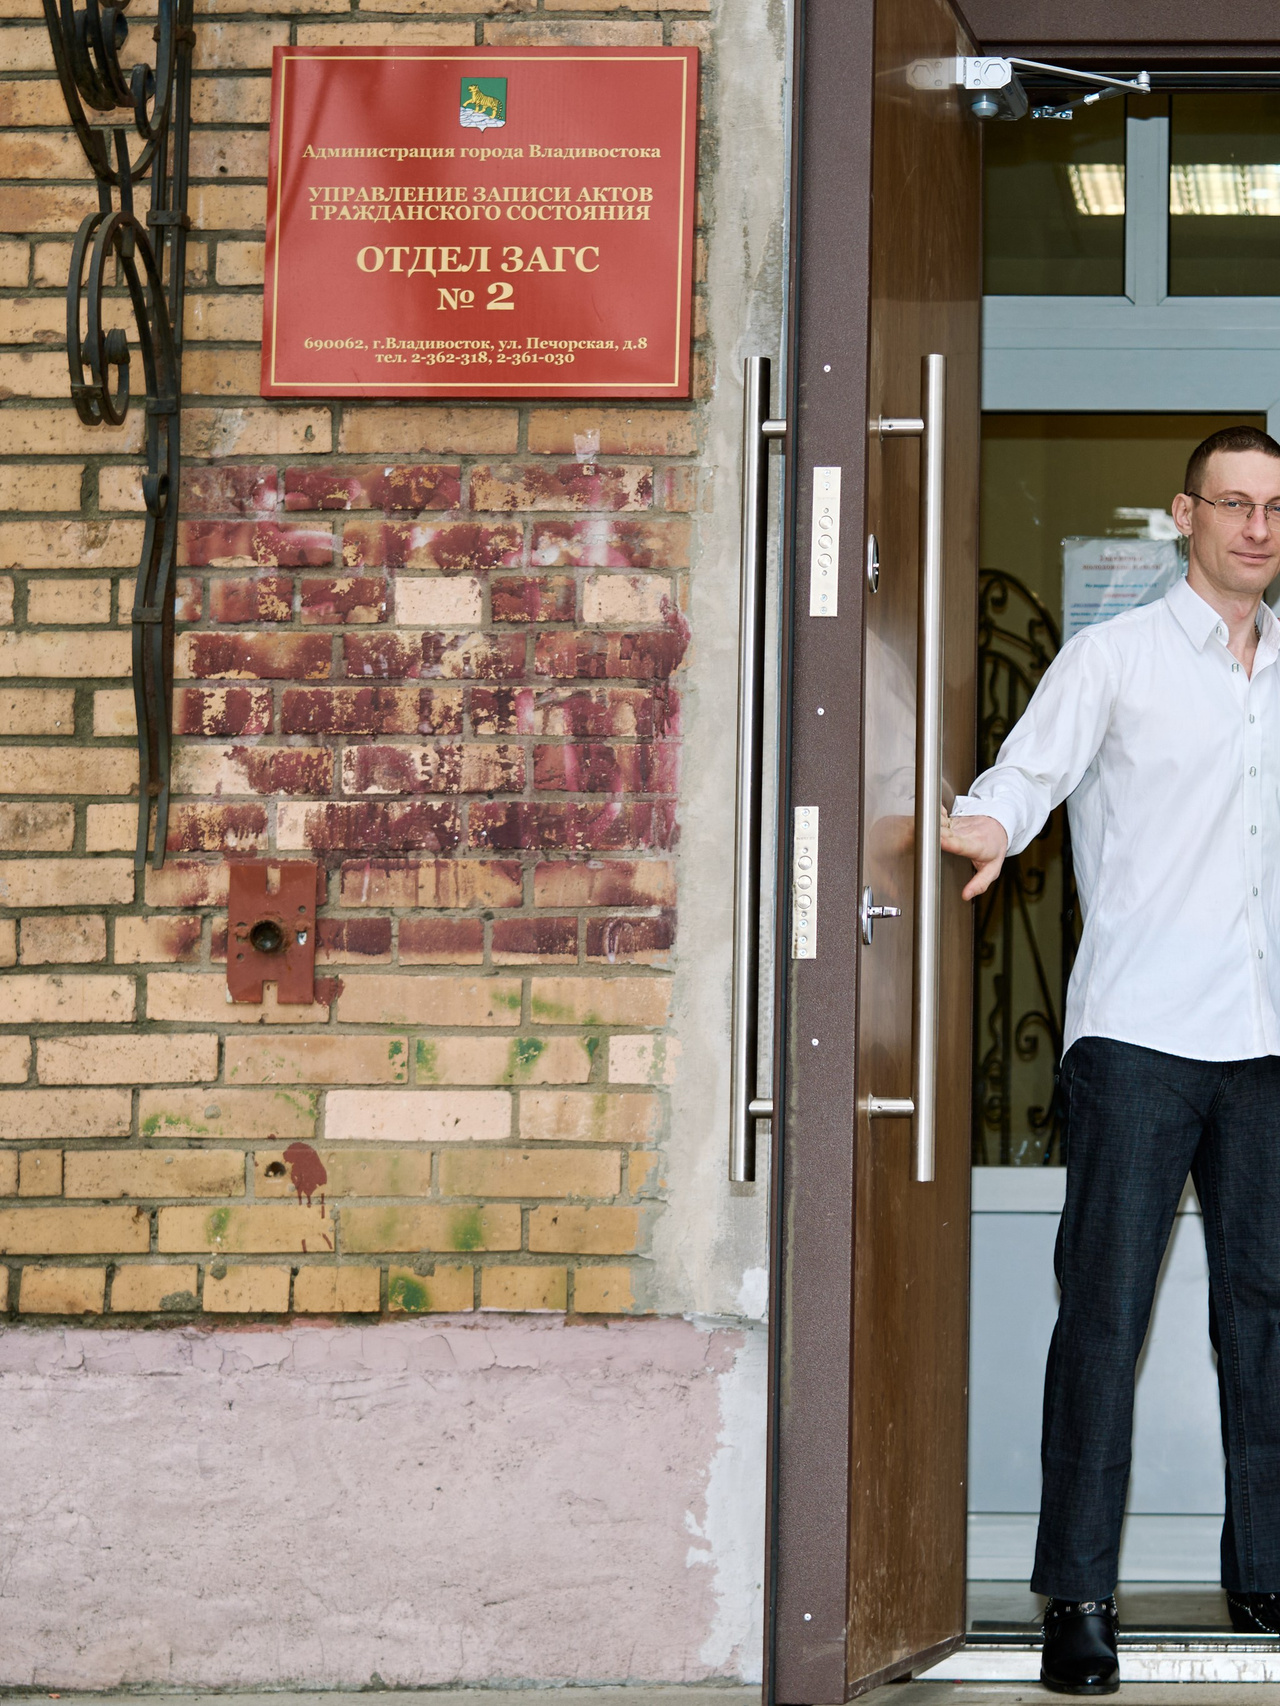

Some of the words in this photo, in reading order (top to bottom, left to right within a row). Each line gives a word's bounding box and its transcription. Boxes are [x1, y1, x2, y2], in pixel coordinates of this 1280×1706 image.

[303, 145, 455, 161] Администрация
[461, 148, 524, 161] города
[529, 145, 661, 159] Владивостока
[308, 187, 468, 202] УПРАВЛЕНИЕ
[473, 187, 571, 202] ЗАПИСИ
[576, 187, 653, 202] АКТОВ
[310, 205, 501, 223] ГРАЖДАНСКОГО
[507, 205, 650, 220] СОСТОЯНИЯ
[356, 246, 491, 277] ОТДЕЛ
[501, 246, 599, 272] ЗАГС
[437, 288, 474, 310] №
[487, 282, 514, 310] 2
[304, 338, 368, 351] 690062,
[498, 341, 522, 352] ул.
[526, 338, 619, 352] Печорская,
[623, 337, 647, 350] д.8
[375, 354, 407, 363] тел.
[411, 352, 492, 365] 2-362-318,
[497, 352, 574, 365] 2-361-030
